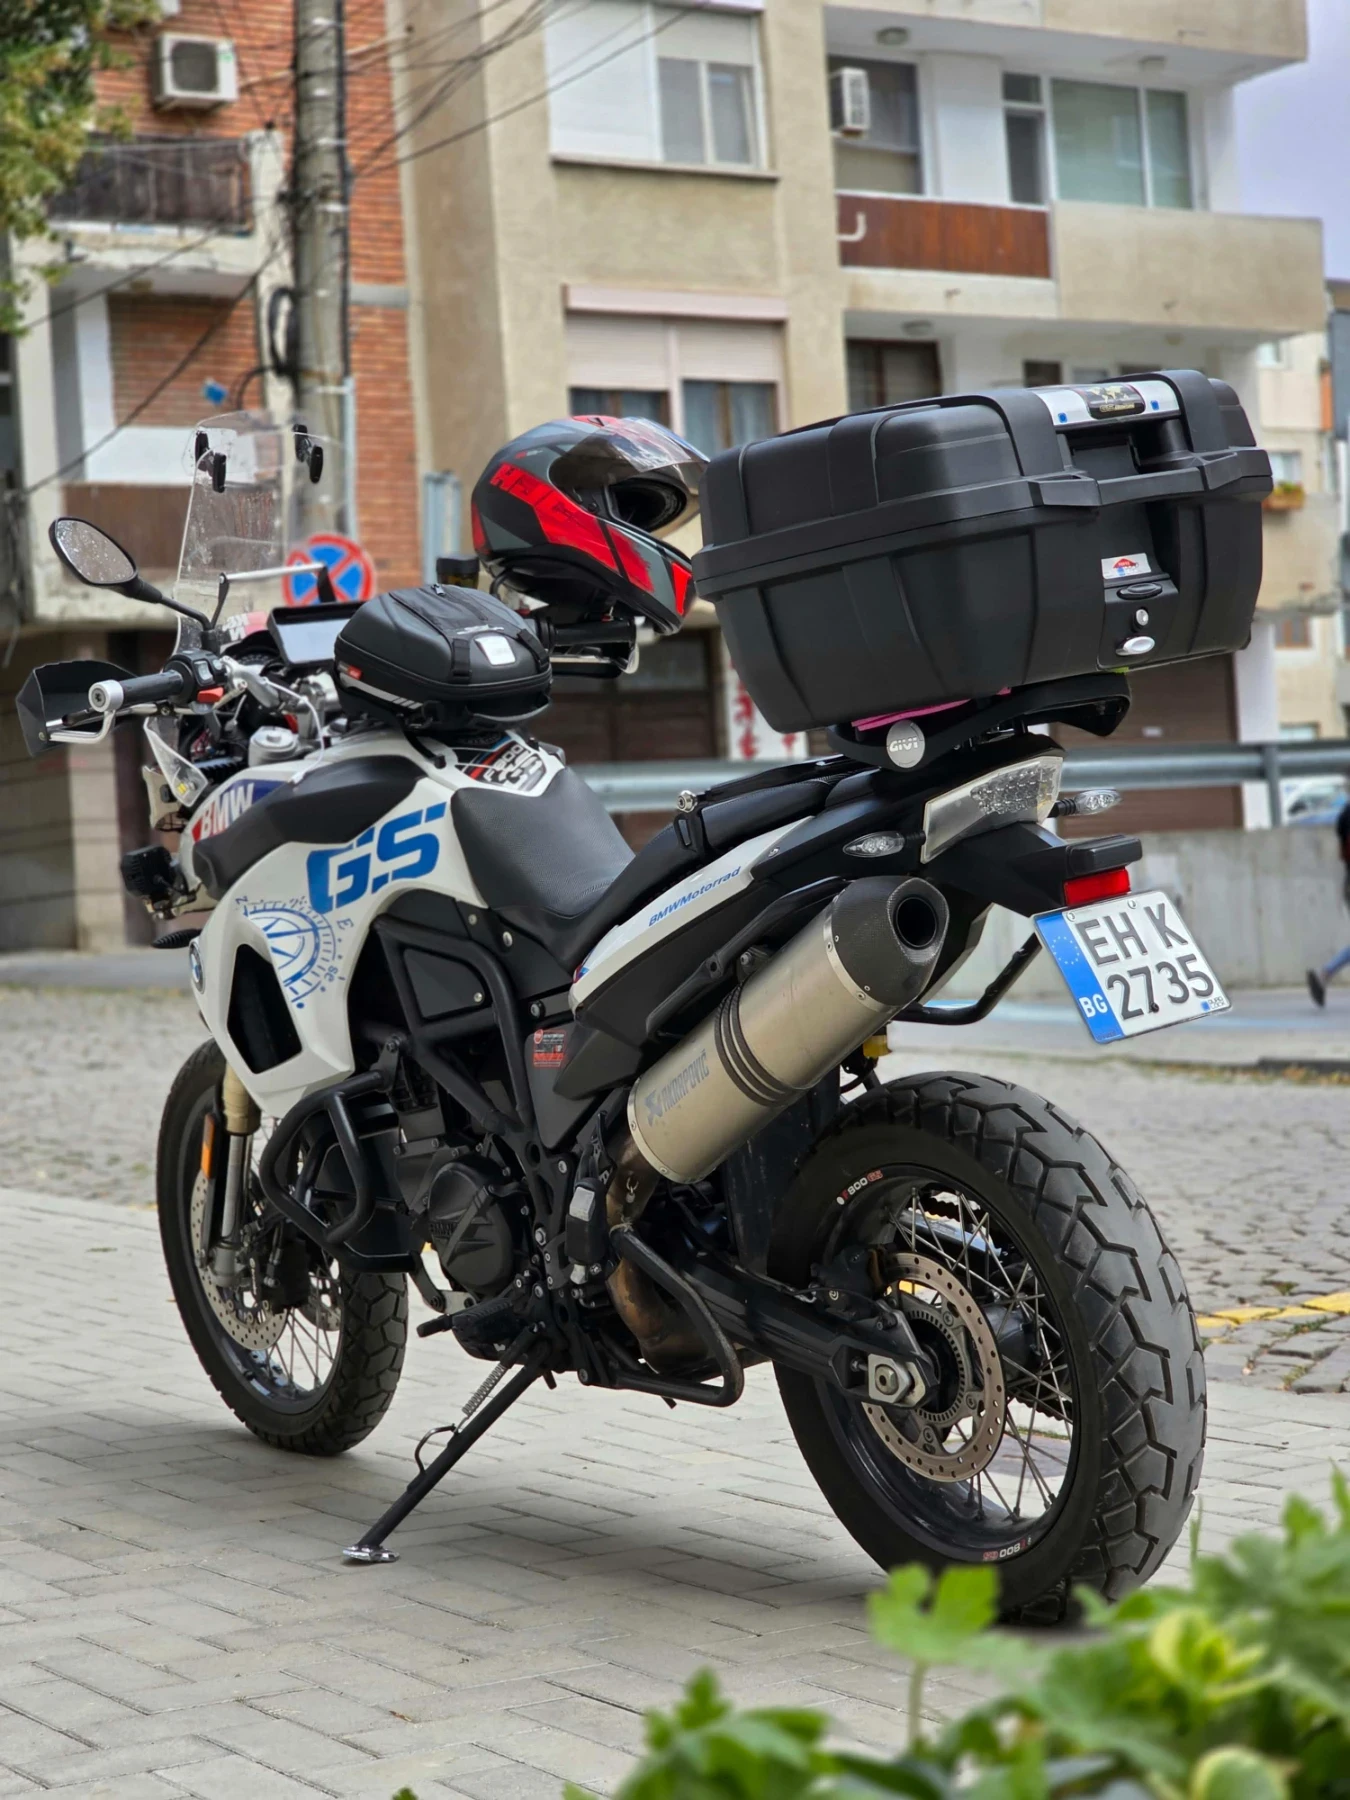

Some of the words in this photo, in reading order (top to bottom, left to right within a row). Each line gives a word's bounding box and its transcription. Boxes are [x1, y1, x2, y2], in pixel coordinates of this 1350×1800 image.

[889, 736, 918, 752] GIVI
[201, 782, 255, 840] BMW
[306, 801, 447, 914] GS
[1074, 911, 1149, 966] EH
[1143, 902, 1189, 950] K
[1078, 993, 1109, 1019] BG
[1106, 952, 1215, 1021] 2735
